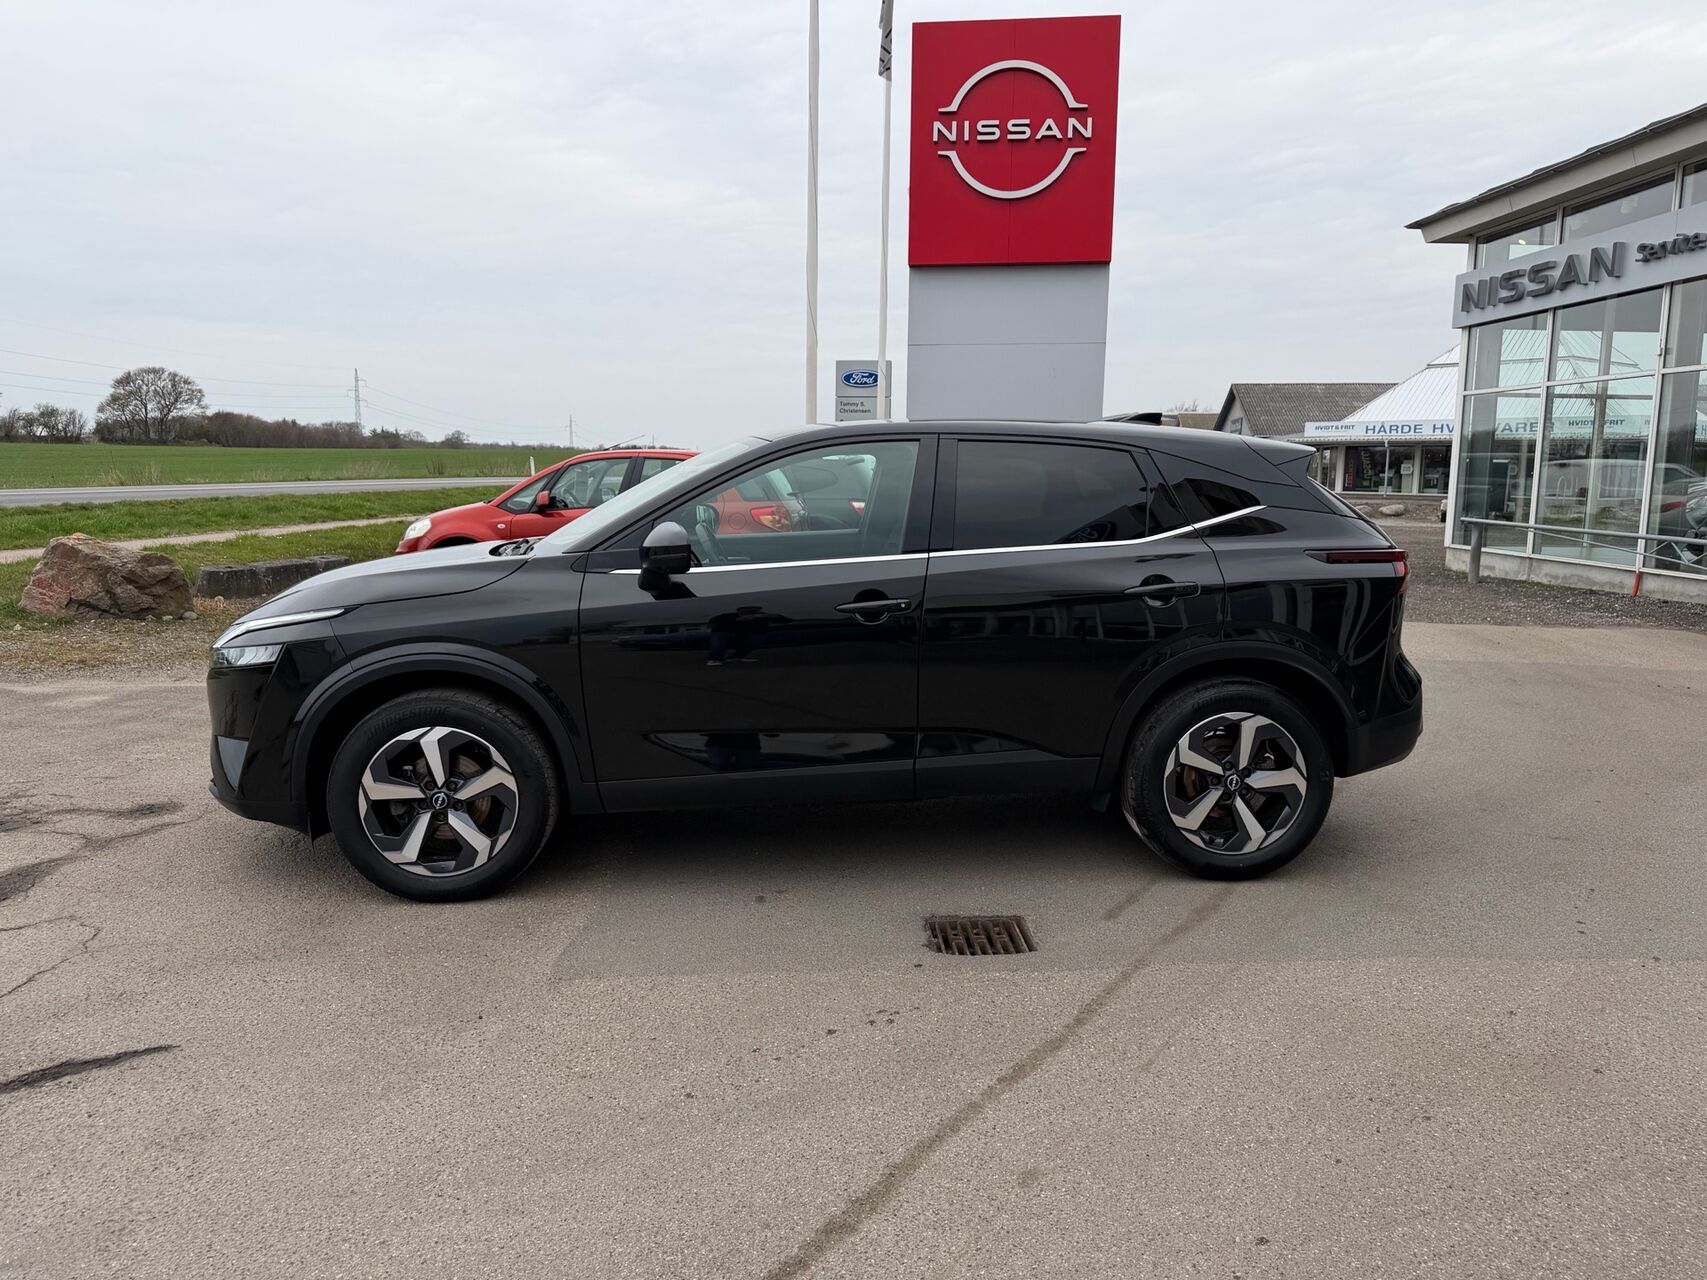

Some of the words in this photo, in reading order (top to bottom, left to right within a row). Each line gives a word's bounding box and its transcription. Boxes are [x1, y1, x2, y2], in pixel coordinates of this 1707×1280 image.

[932, 116, 1093, 143] NISSAN
[1461, 241, 1626, 313] NISSAN
[850, 372, 876, 384] Ford
[1365, 421, 1423, 434] HÅRDE
